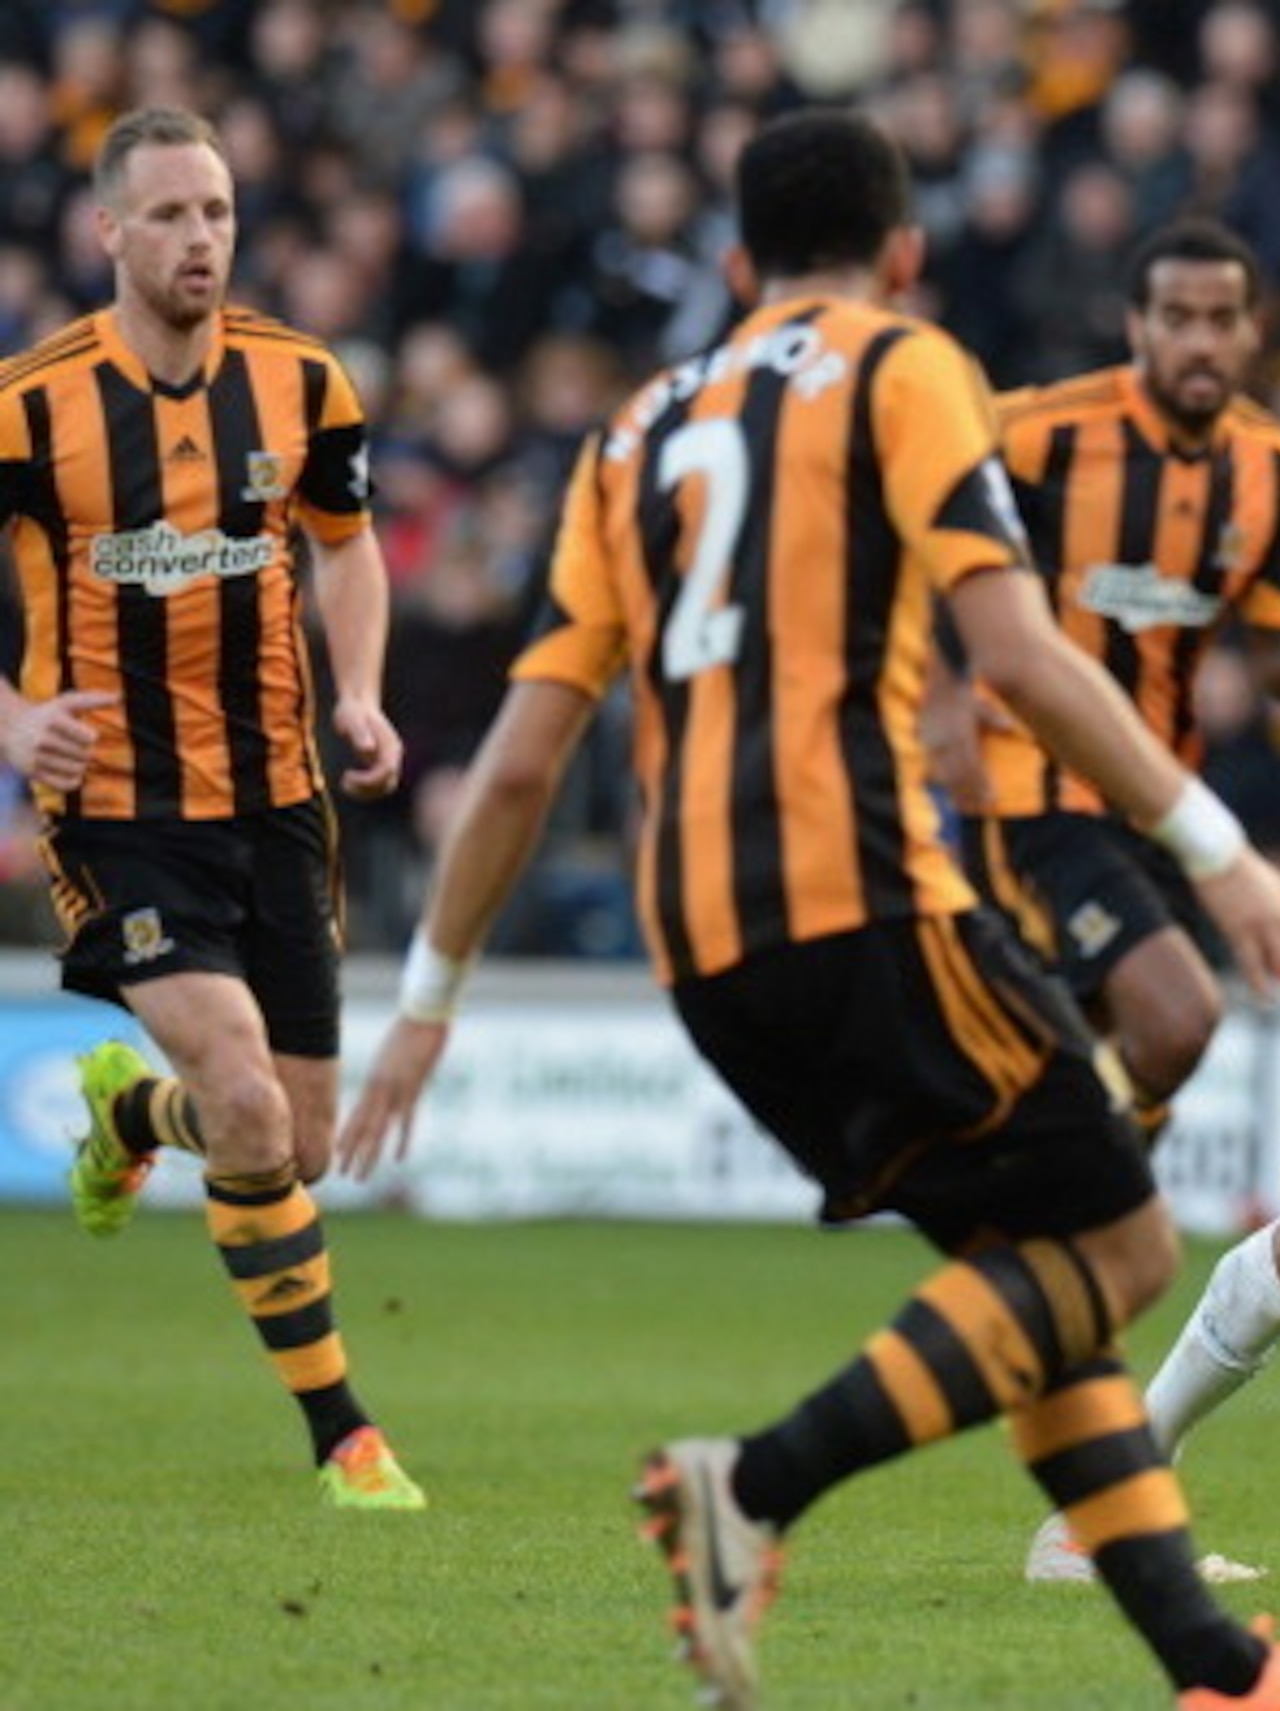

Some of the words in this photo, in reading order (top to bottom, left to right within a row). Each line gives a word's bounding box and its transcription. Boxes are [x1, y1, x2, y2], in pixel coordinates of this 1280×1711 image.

[95, 528, 175, 557] cash
[95, 540, 272, 576] converters
[656, 416, 748, 682] 2
